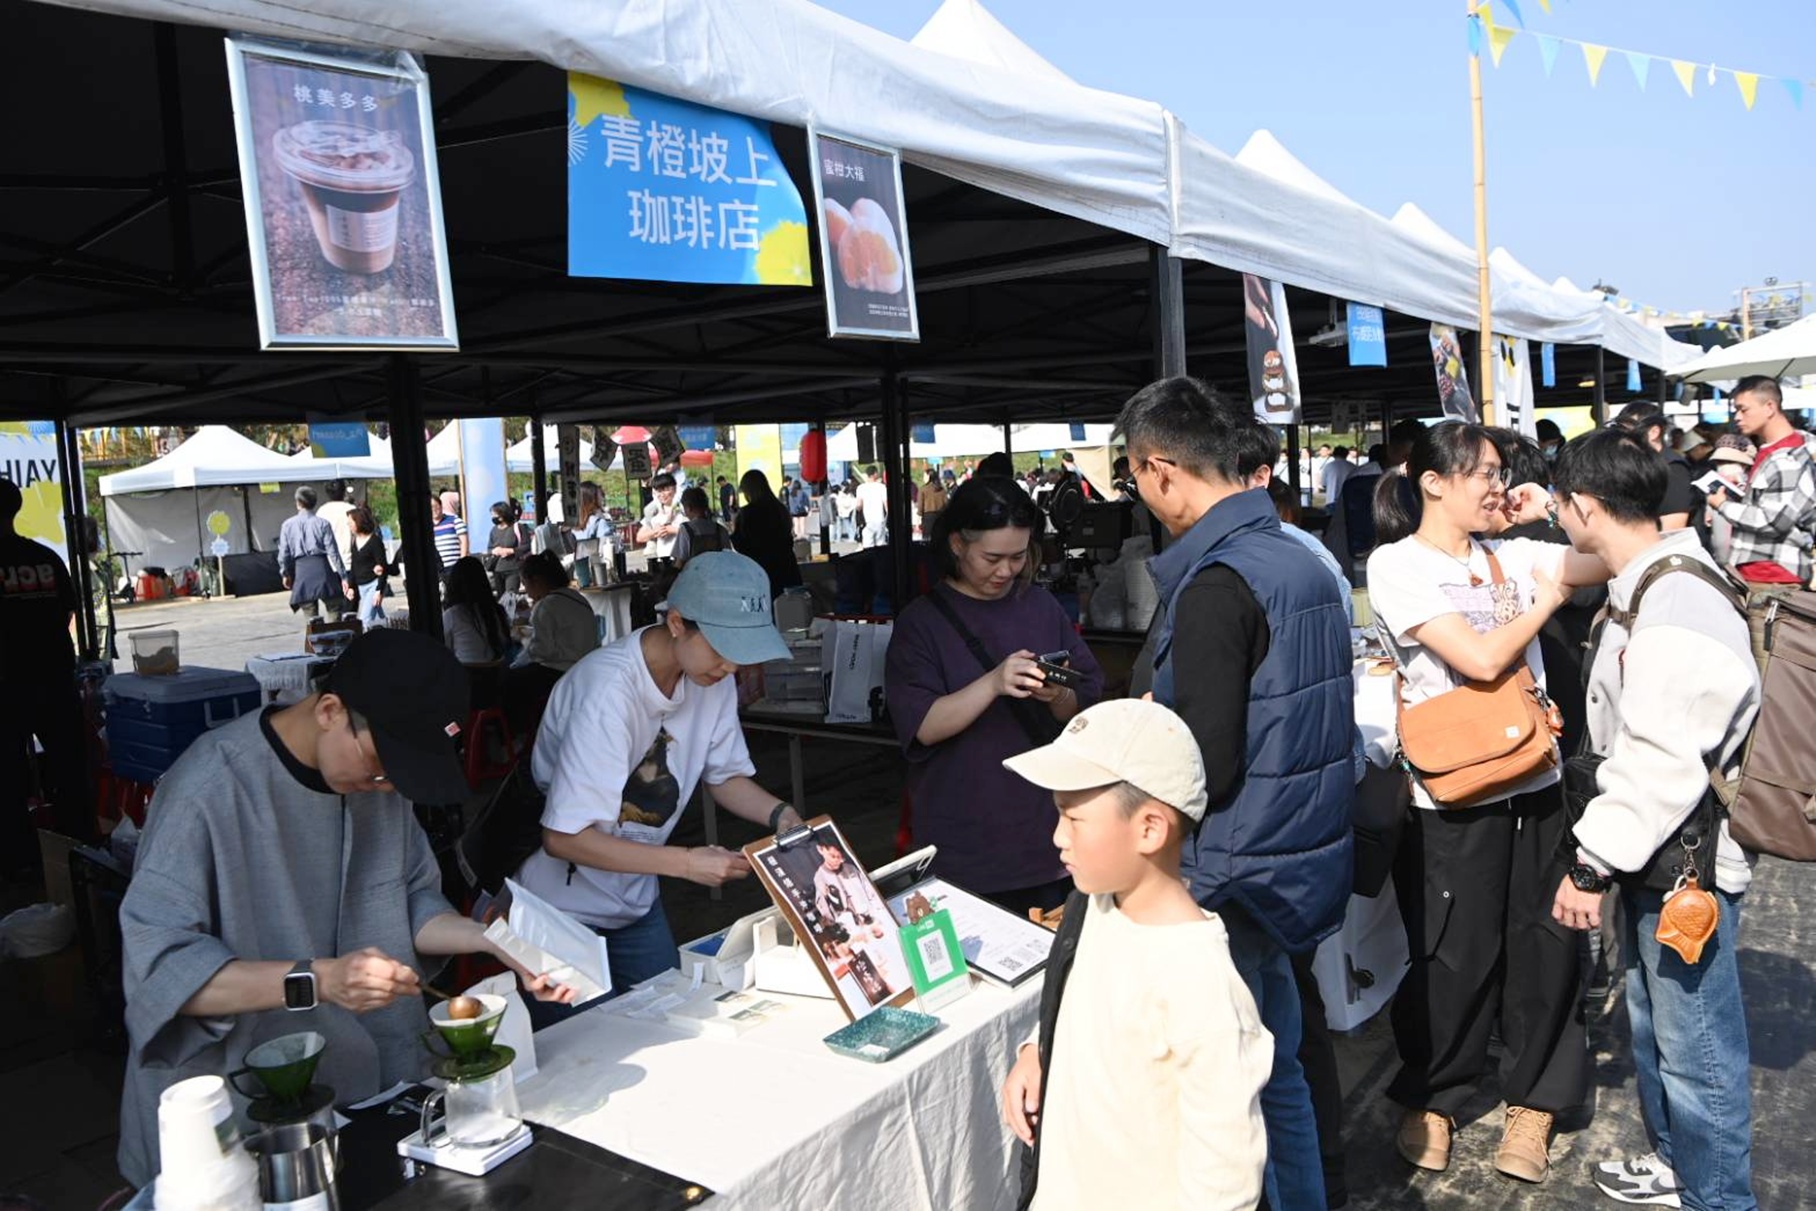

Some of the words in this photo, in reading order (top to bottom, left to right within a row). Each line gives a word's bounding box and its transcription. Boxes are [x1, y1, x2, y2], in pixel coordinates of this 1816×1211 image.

[601, 114, 778, 187] 青橙坡上
[627, 188, 760, 251] 珈琲店
